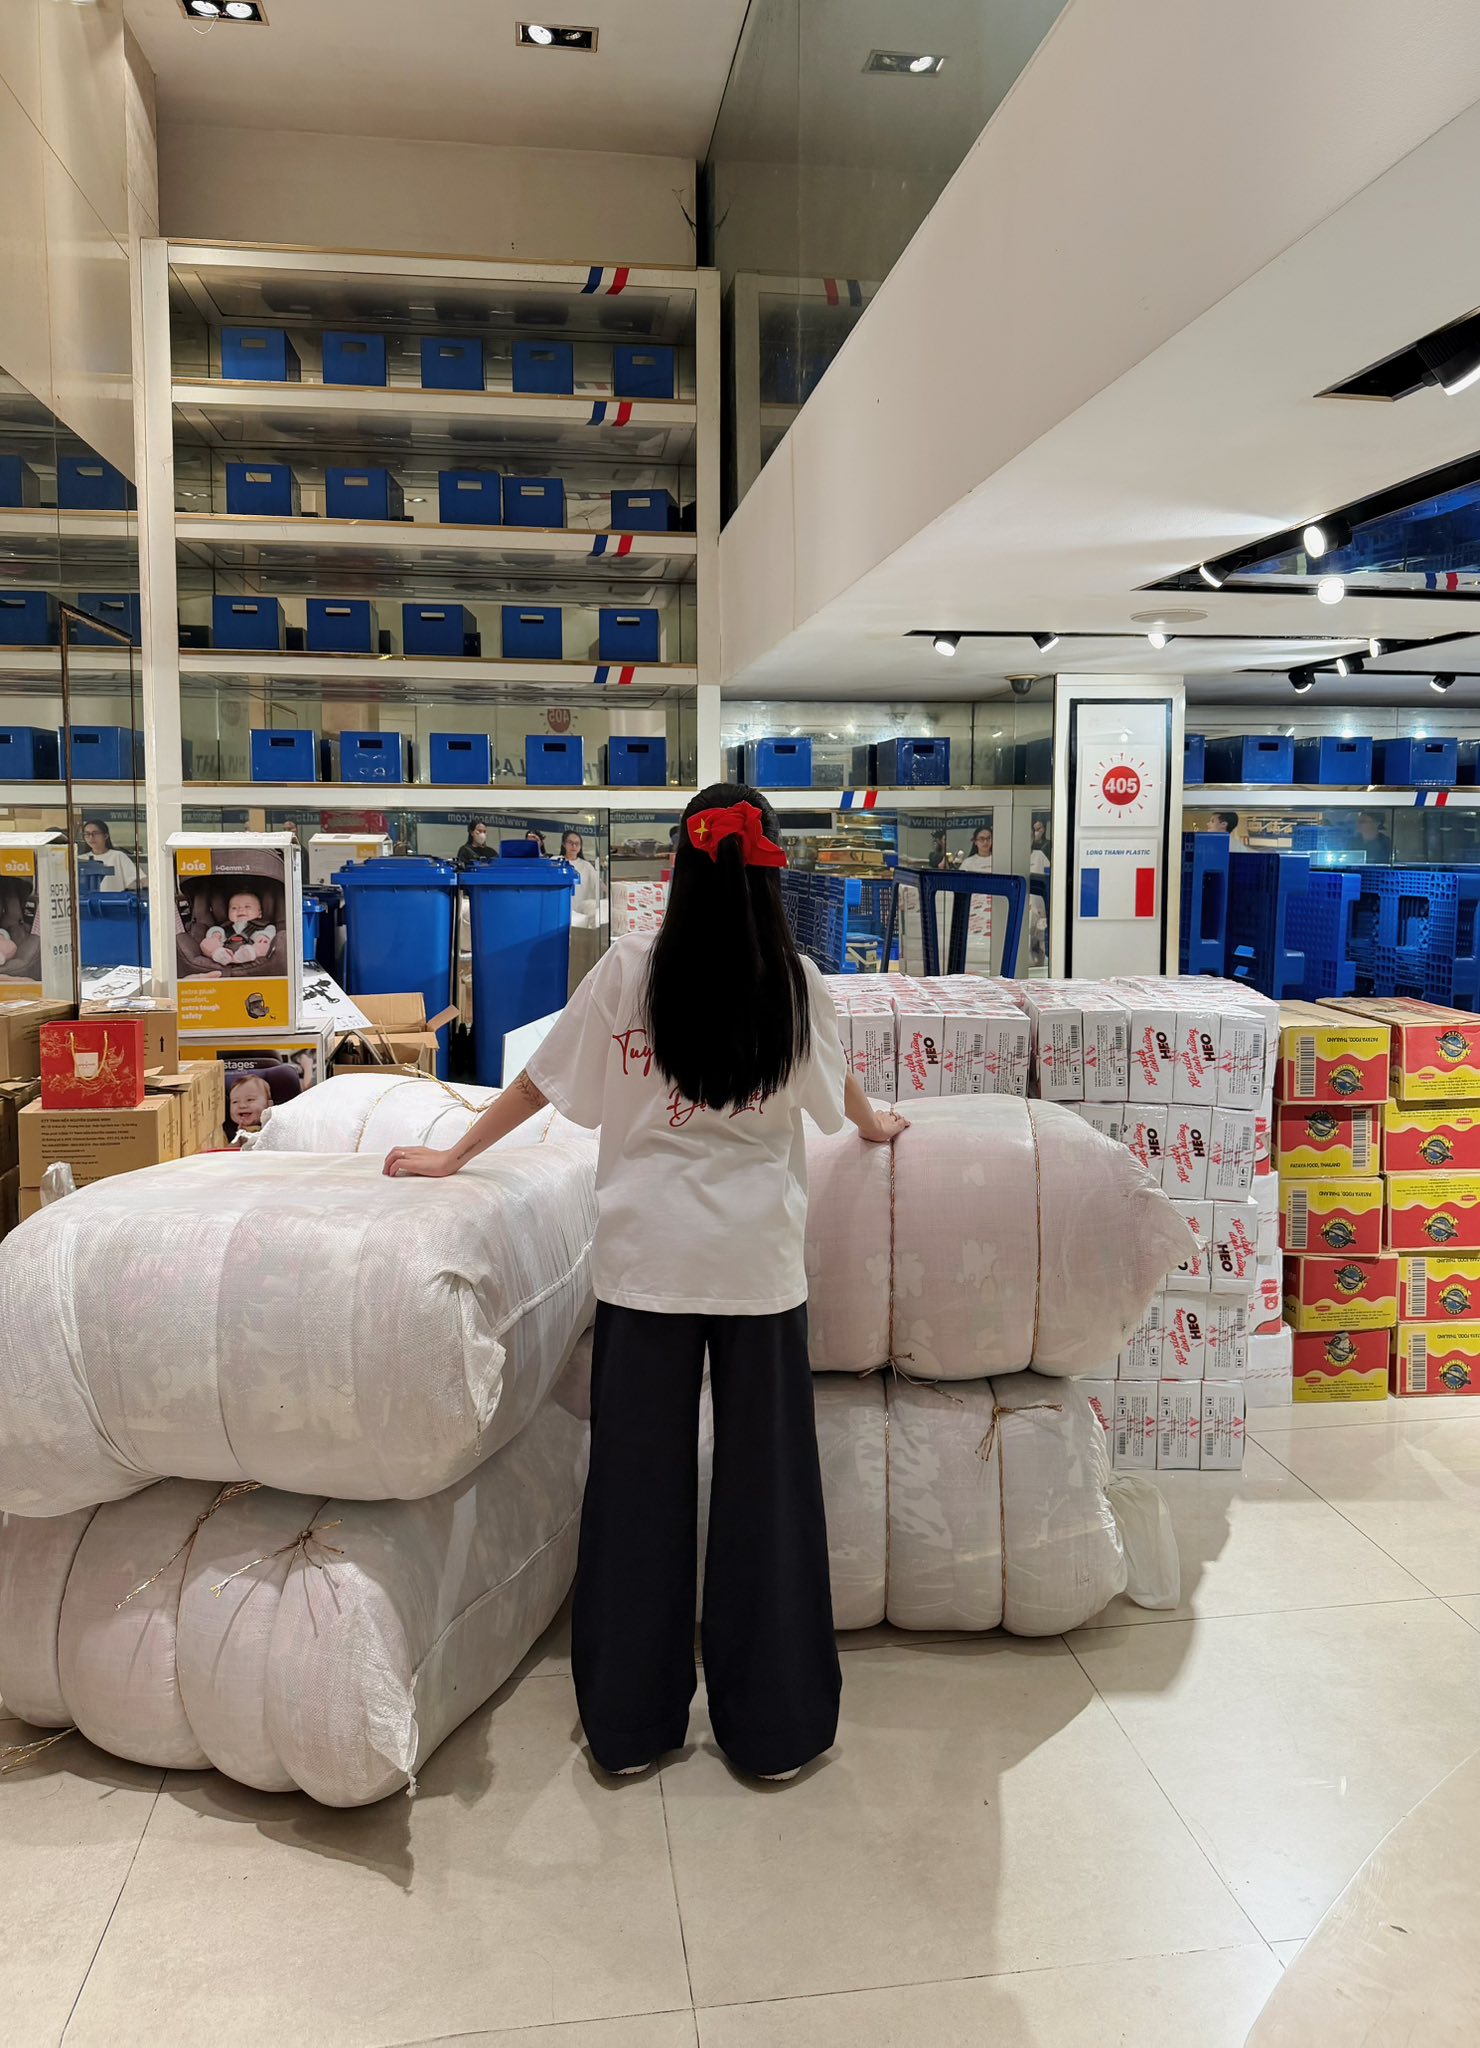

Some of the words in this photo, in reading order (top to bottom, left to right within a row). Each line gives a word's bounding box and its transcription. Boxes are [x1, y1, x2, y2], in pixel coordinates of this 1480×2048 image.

[1105, 777, 1138, 794] 405
[181, 859, 207, 872] Joie
[181, 1012, 203, 1021] safety
[923, 1037, 939, 1065] HEO
[1156, 1031, 1171, 1059] HEO
[1200, 1033, 1216, 1061] HEO
[1146, 1128, 1161, 1156] HEO
[1190, 1129, 1205, 1157] HEO
[1217, 1244, 1233, 1272] HEO
[1186, 1313, 1202, 1340] HEO
